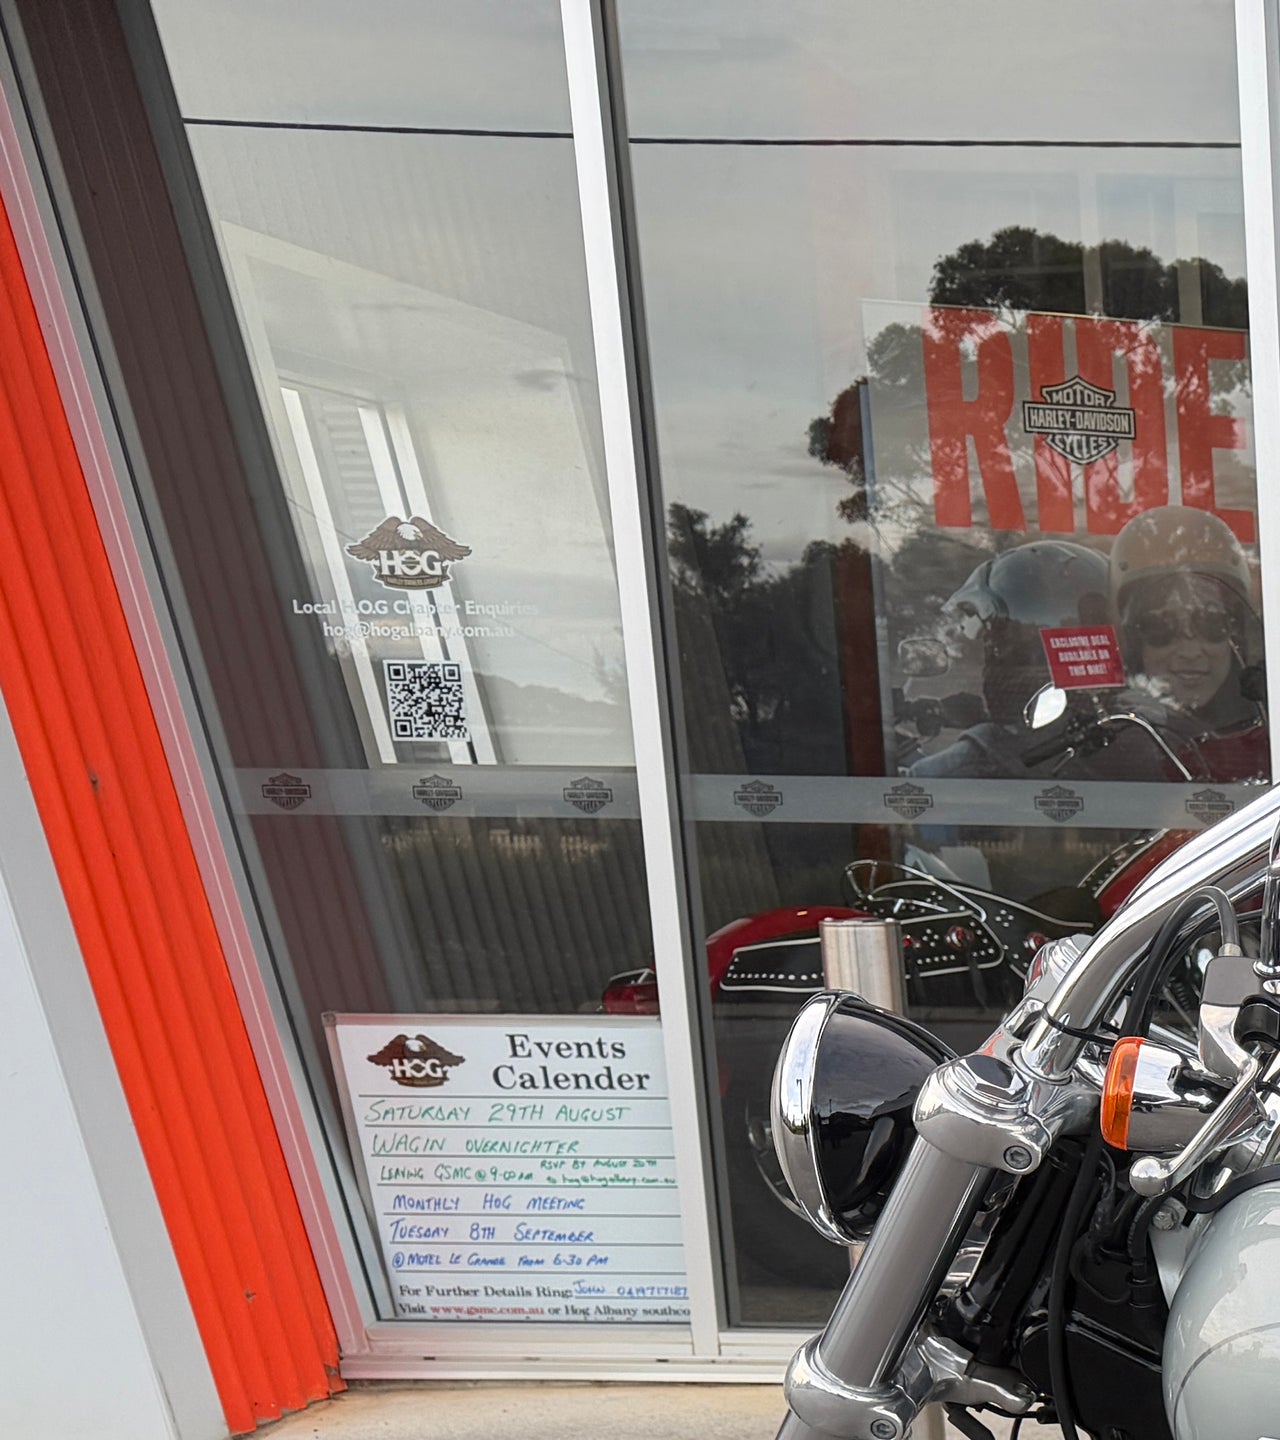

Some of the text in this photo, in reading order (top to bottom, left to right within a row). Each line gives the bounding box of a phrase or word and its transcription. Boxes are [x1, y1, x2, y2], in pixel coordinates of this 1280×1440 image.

[1051, 389, 1106, 407] MOTOR
[921, 307, 1257, 543] RIDE
[1029, 408, 1130, 433] HARLEY-DAVIDSON
[1053, 435, 1111, 460] CYCLES
[293, 600, 335, 614] Local
[393, 600, 460, 618] Chapter
[505, 1033, 626, 1059] Events
[492, 1065, 650, 1091] Calender
[488, 1103, 543, 1123] 29TH
[555, 1104, 632, 1122] AUGUST
[372, 1132, 580, 1155] WAGIN OVERNIGHTER
[393, 1194, 585, 1210] MONTHLY HOG MEETING
[390, 1219, 594, 1242] TUESDAY 8TH SEPTEMBER
[399, 1285, 422, 1296] For
[425, 1285, 479, 1296] Further
[484, 1286, 532, 1297] Details
[399, 1303, 426, 1313] Visit
[564, 1304, 590, 1316] Hog
[594, 1305, 638, 1317] Albany
